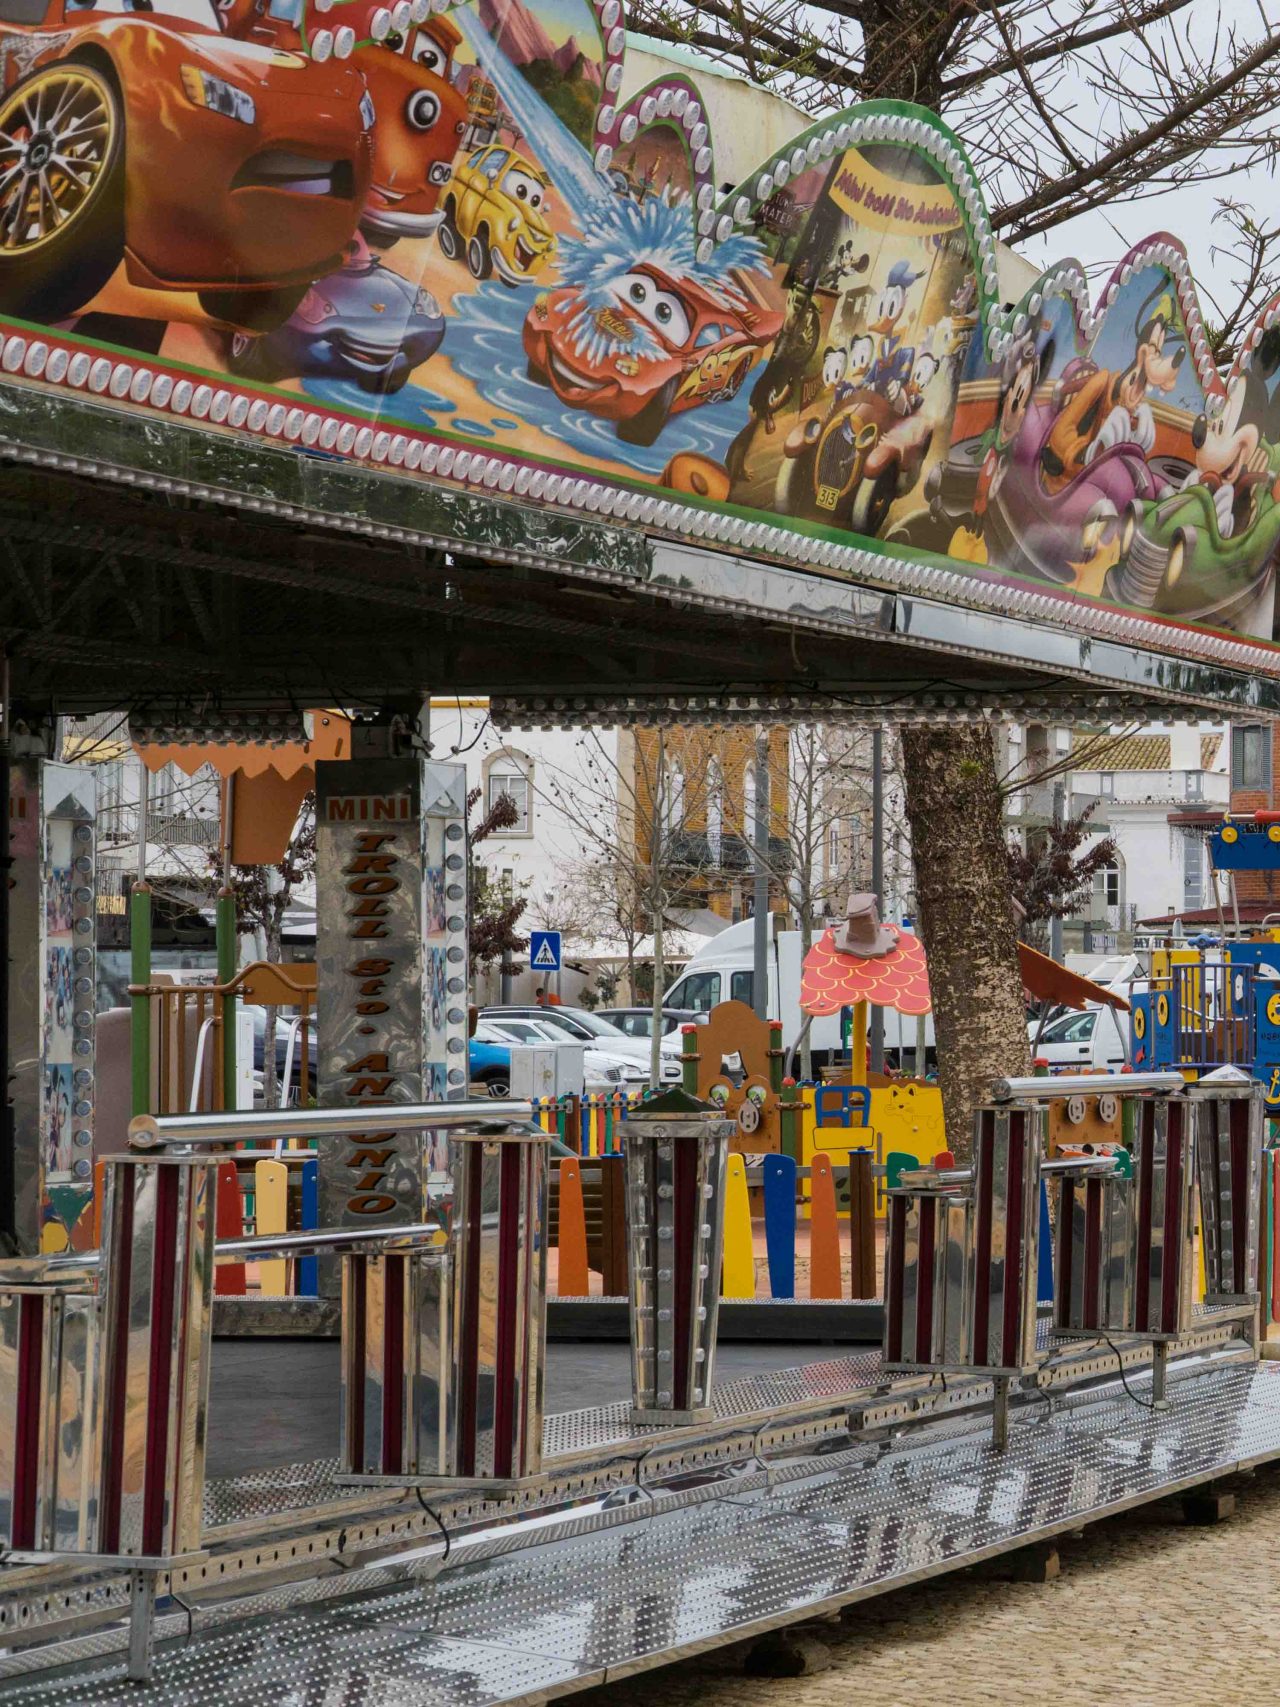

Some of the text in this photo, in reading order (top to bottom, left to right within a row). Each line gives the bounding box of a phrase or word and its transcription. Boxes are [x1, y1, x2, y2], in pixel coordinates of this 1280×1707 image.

[820, 488, 836, 506] 313
[328, 798, 411, 820] MINI
[347, 831, 400, 938] TROLL
[348, 957, 393, 1035] Sto.
